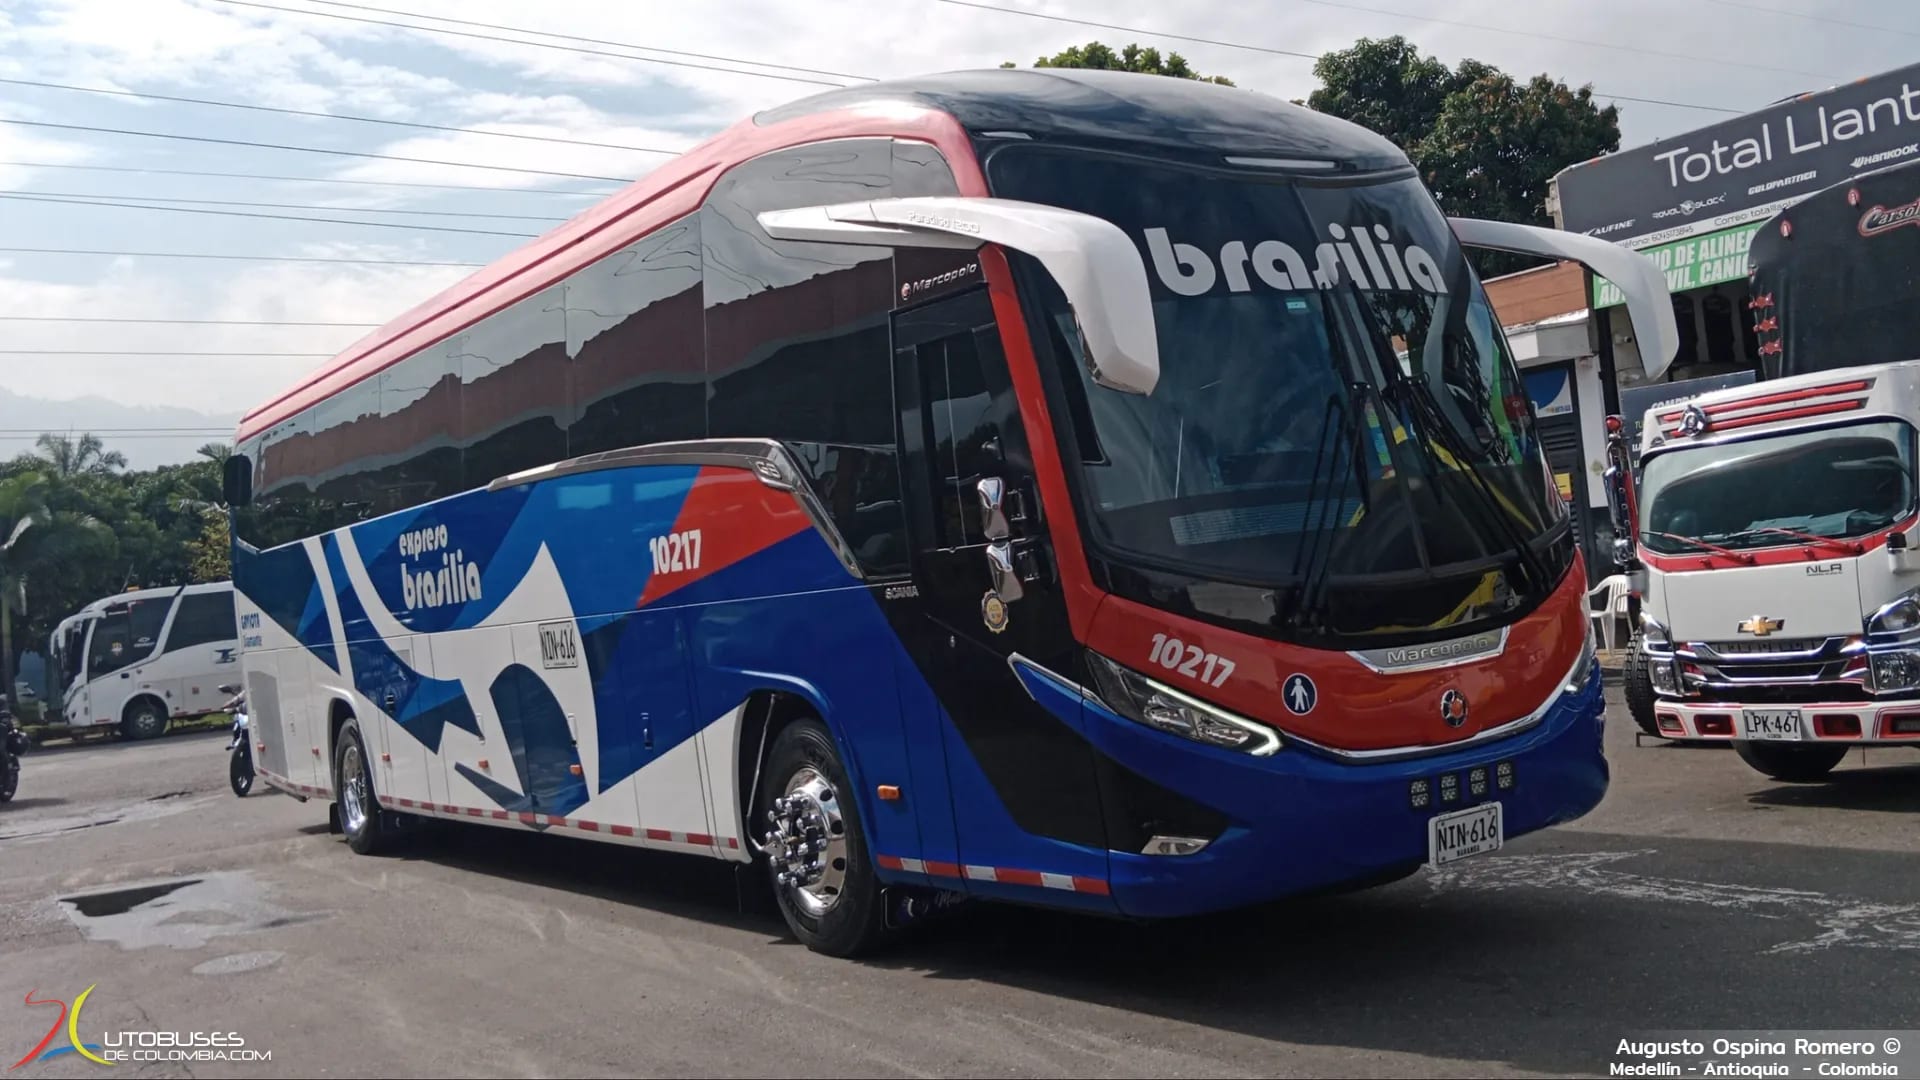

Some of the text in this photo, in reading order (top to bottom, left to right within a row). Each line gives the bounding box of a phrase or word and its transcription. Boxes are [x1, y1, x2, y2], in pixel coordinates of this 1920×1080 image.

[1654, 123, 1772, 187] Total
[1144, 222, 1448, 296] brasilia
[1675, 242, 1696, 267] DE
[913, 263, 977, 294] Marcopolo
[399, 524, 448, 561] expreso
[649, 529, 702, 575] 10217
[400, 548, 482, 610] brasilia
[885, 585, 919, 600] SCANIA
[1148, 632, 1236, 688] 10217
[1386, 636, 1489, 664] Marcopolo
